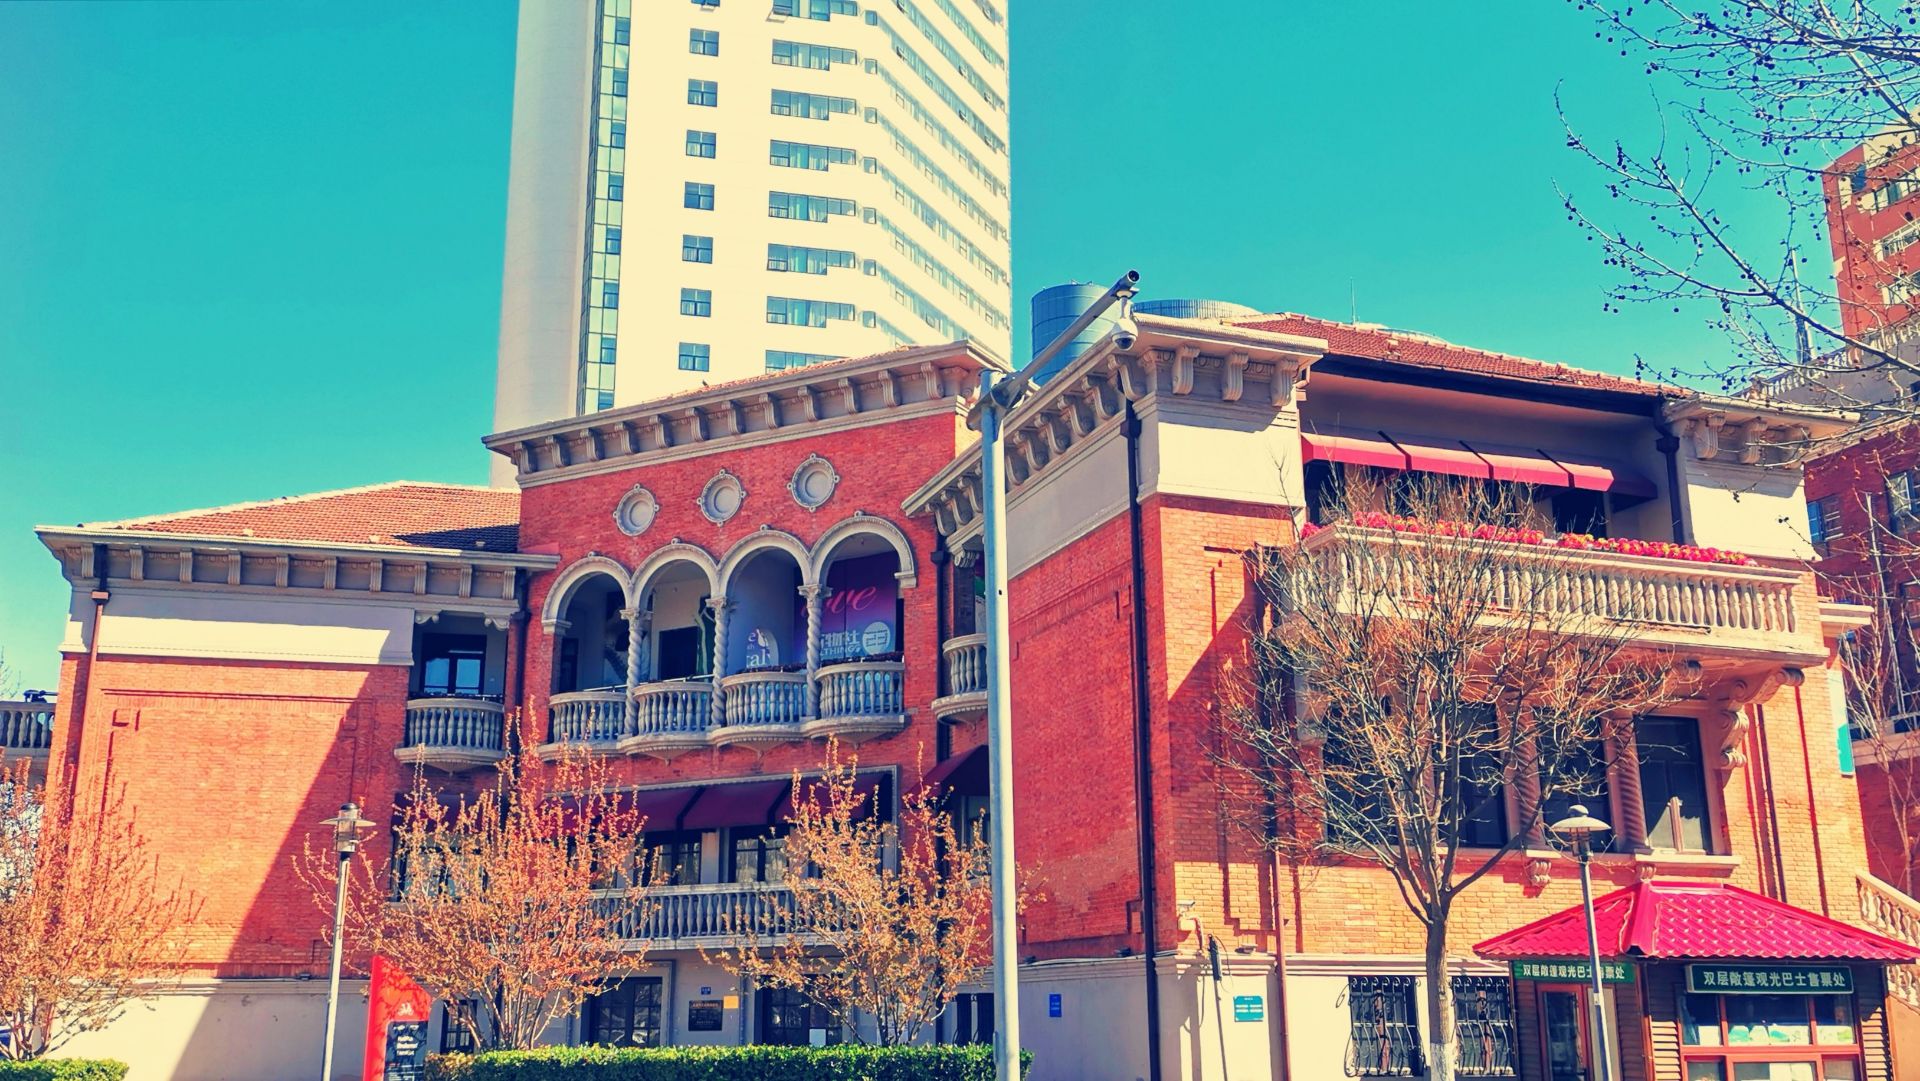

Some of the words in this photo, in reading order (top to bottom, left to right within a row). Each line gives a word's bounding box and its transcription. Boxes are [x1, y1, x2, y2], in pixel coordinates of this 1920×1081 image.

[1703, 971, 1846, 987] 双层敞篷观光巴士售票处
